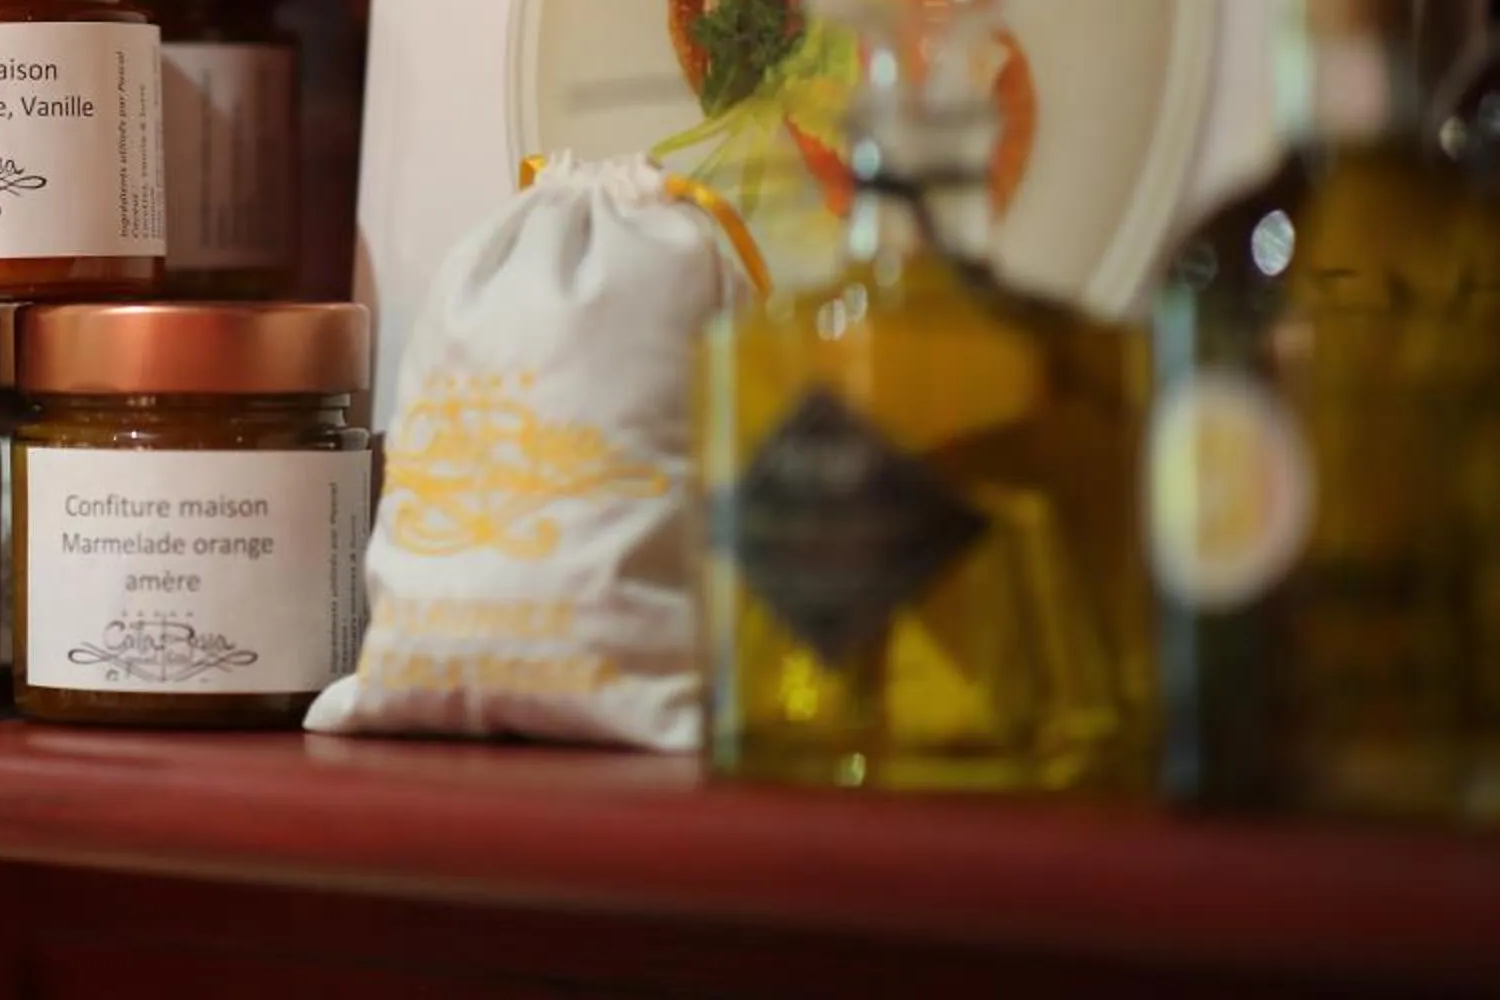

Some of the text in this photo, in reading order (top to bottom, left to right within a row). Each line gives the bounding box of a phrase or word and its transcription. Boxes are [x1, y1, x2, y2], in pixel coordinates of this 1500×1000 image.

[20, 96, 95, 118] Vanille
[64, 494, 269, 518] Confiture maison
[62, 533, 275, 559] Marmelade orange
[125, 571, 202, 593] amère
